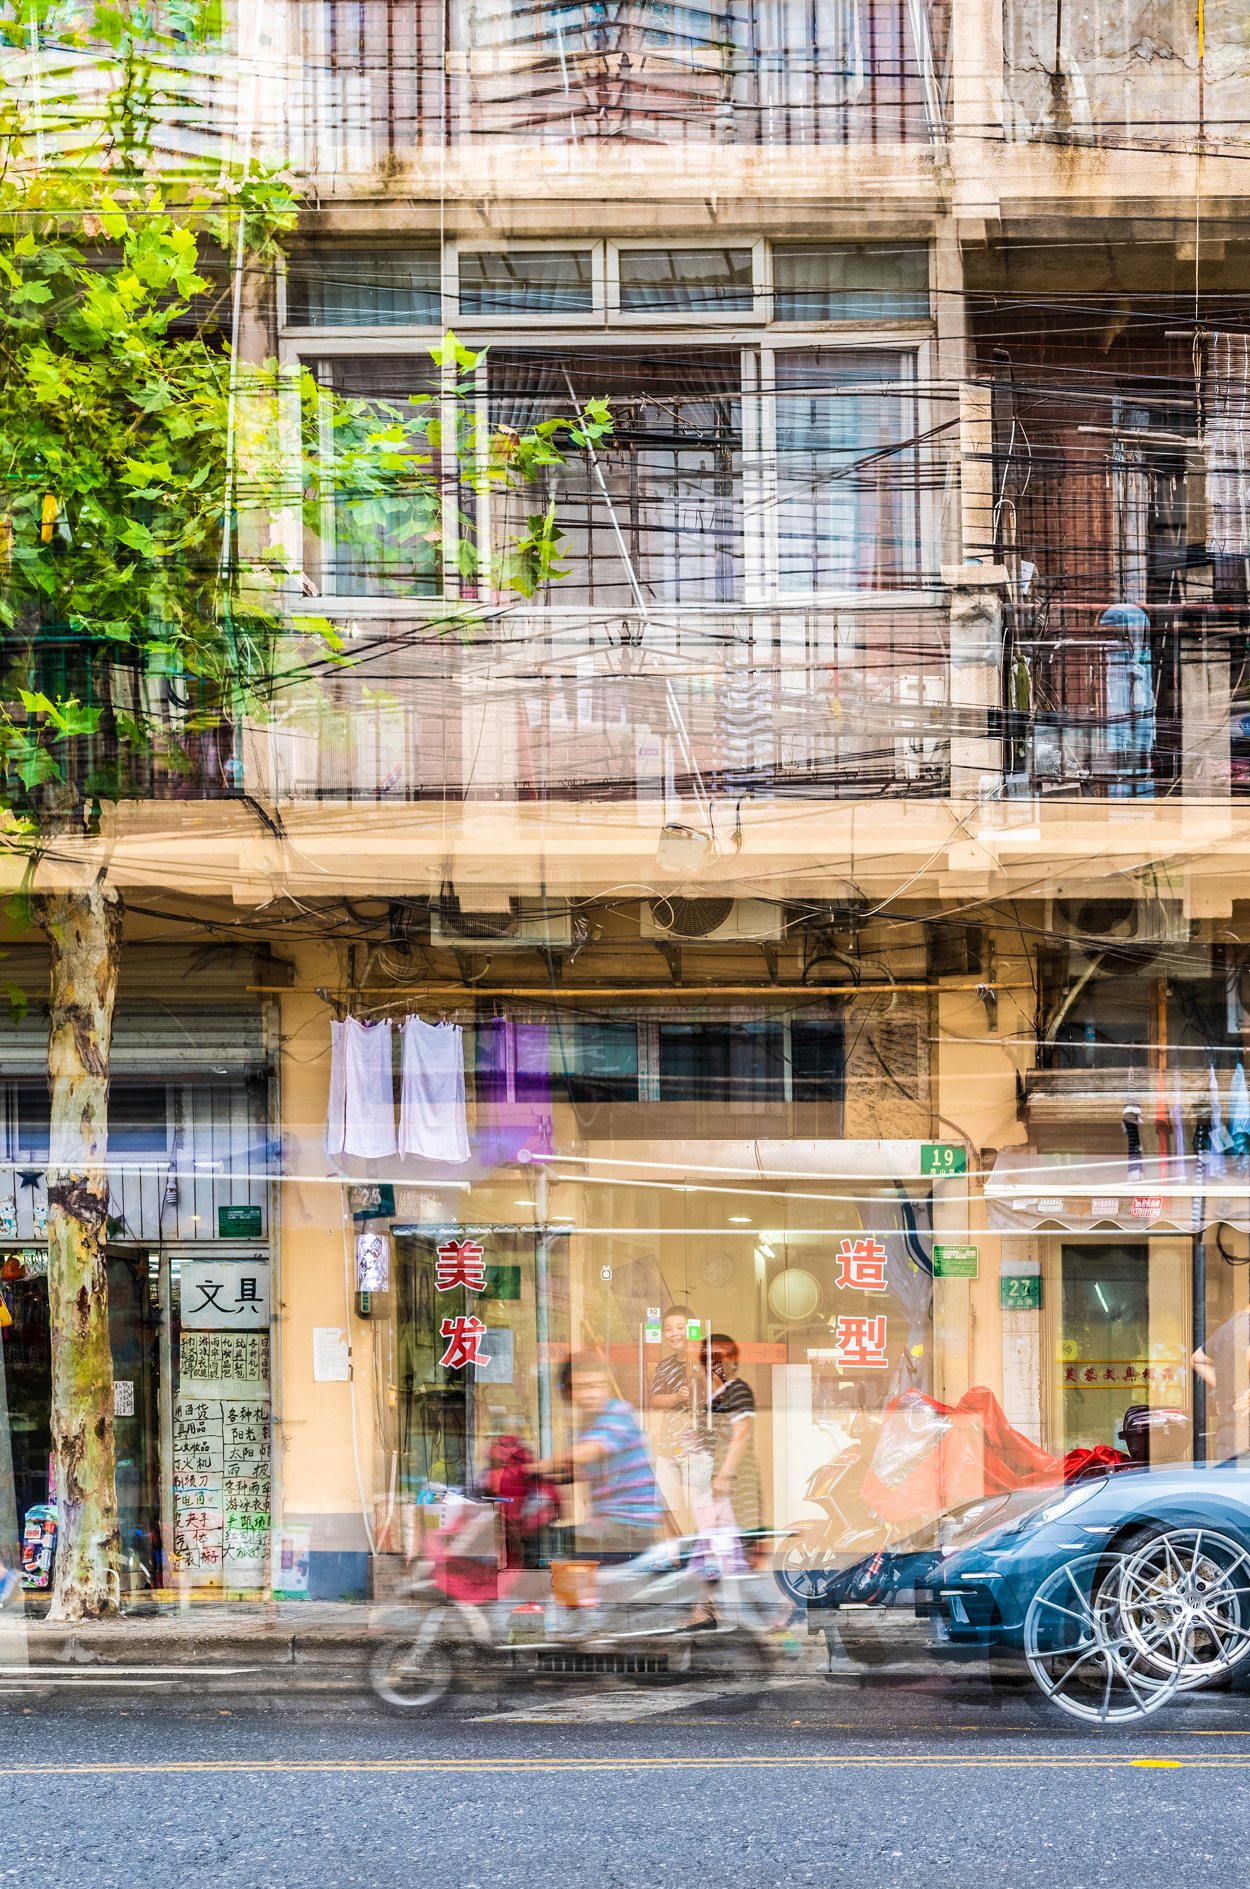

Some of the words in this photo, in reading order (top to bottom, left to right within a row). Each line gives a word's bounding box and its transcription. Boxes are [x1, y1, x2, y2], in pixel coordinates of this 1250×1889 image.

[932, 1149, 953, 1166] 19
[188, 1277, 264, 1314] 文具
[434, 1239, 491, 1370] 美发
[835, 1238, 889, 1368] 造型
[1010, 1280, 1030, 1296] 27
